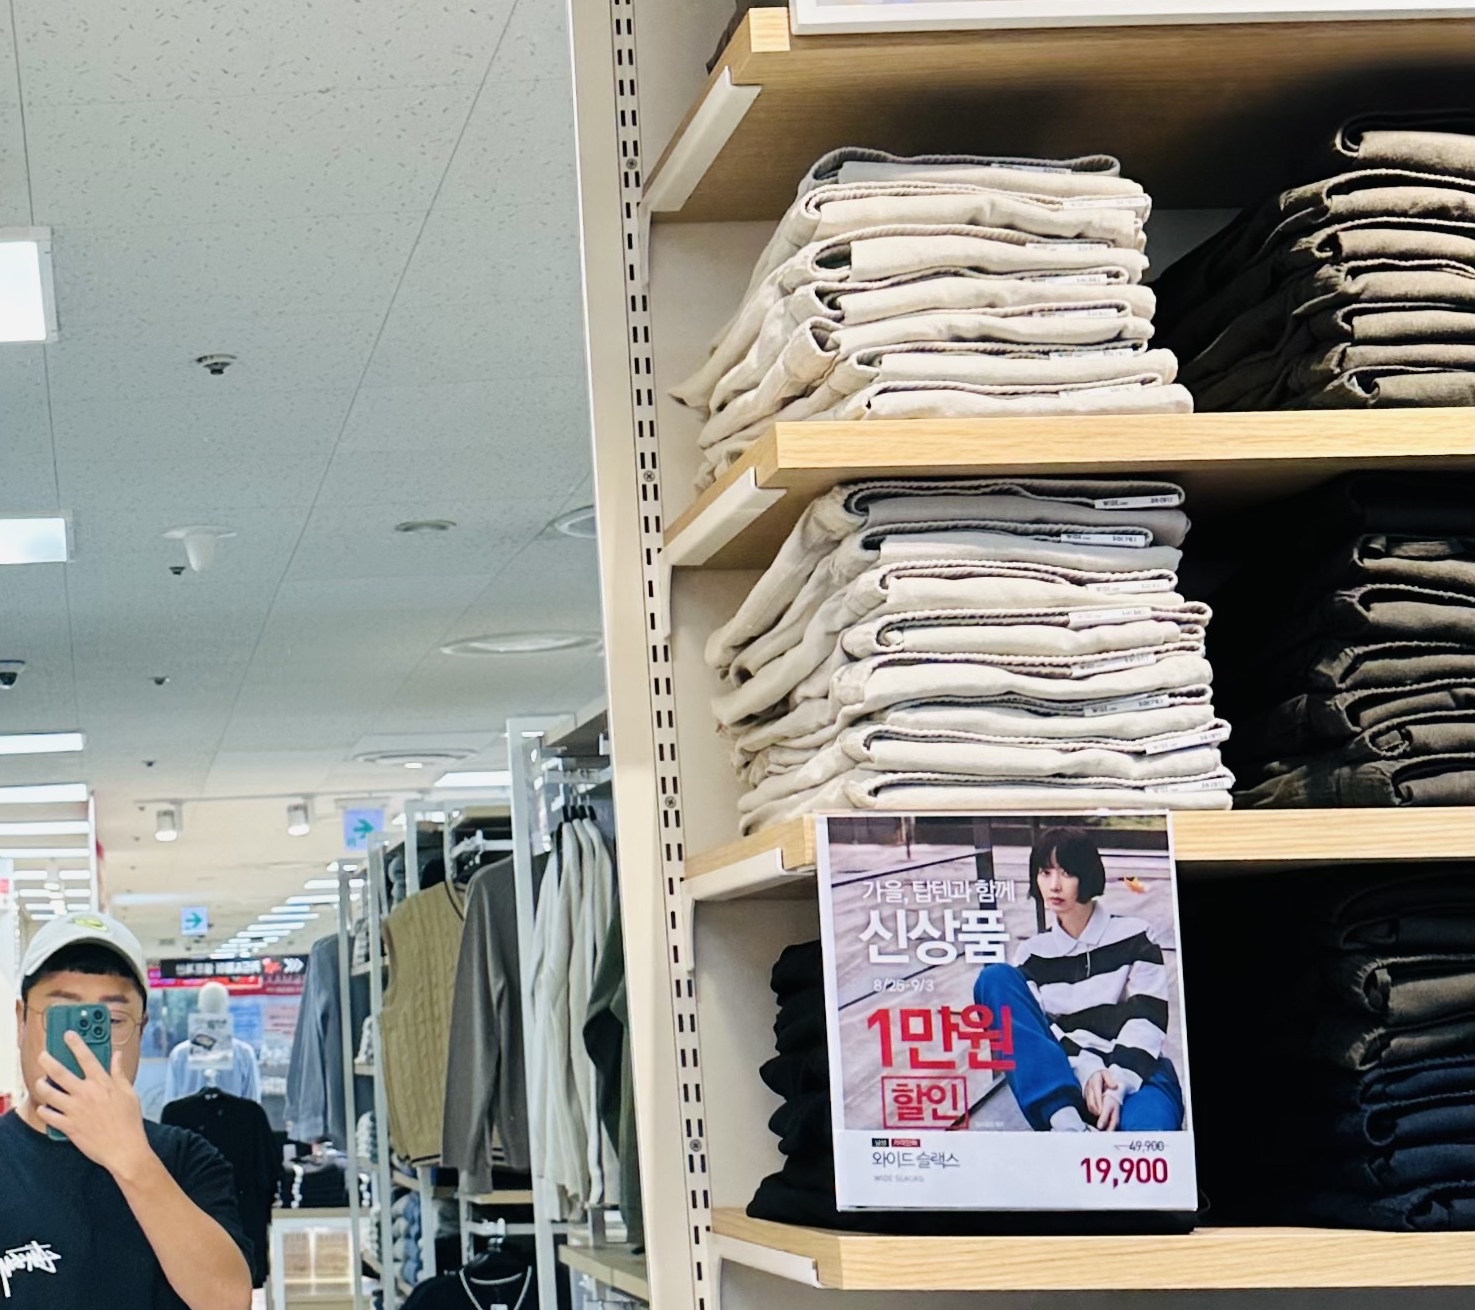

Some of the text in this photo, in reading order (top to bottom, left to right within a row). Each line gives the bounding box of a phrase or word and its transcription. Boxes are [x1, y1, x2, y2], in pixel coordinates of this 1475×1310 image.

[862, 879, 1016, 905] 가을, 탑텐과 함께
[858, 908, 1011, 965] 신상품
[873, 978, 935, 993] 8/25-9/3
[866, 1004, 1017, 1071] 1만원
[891, 1083, 960, 1121] 할인
[872, 1151, 961, 1169] 와이드 슬랙스
[1128, 1140, 1165, 1153] 49,900
[1080, 1157, 1169, 1189] 19,900
